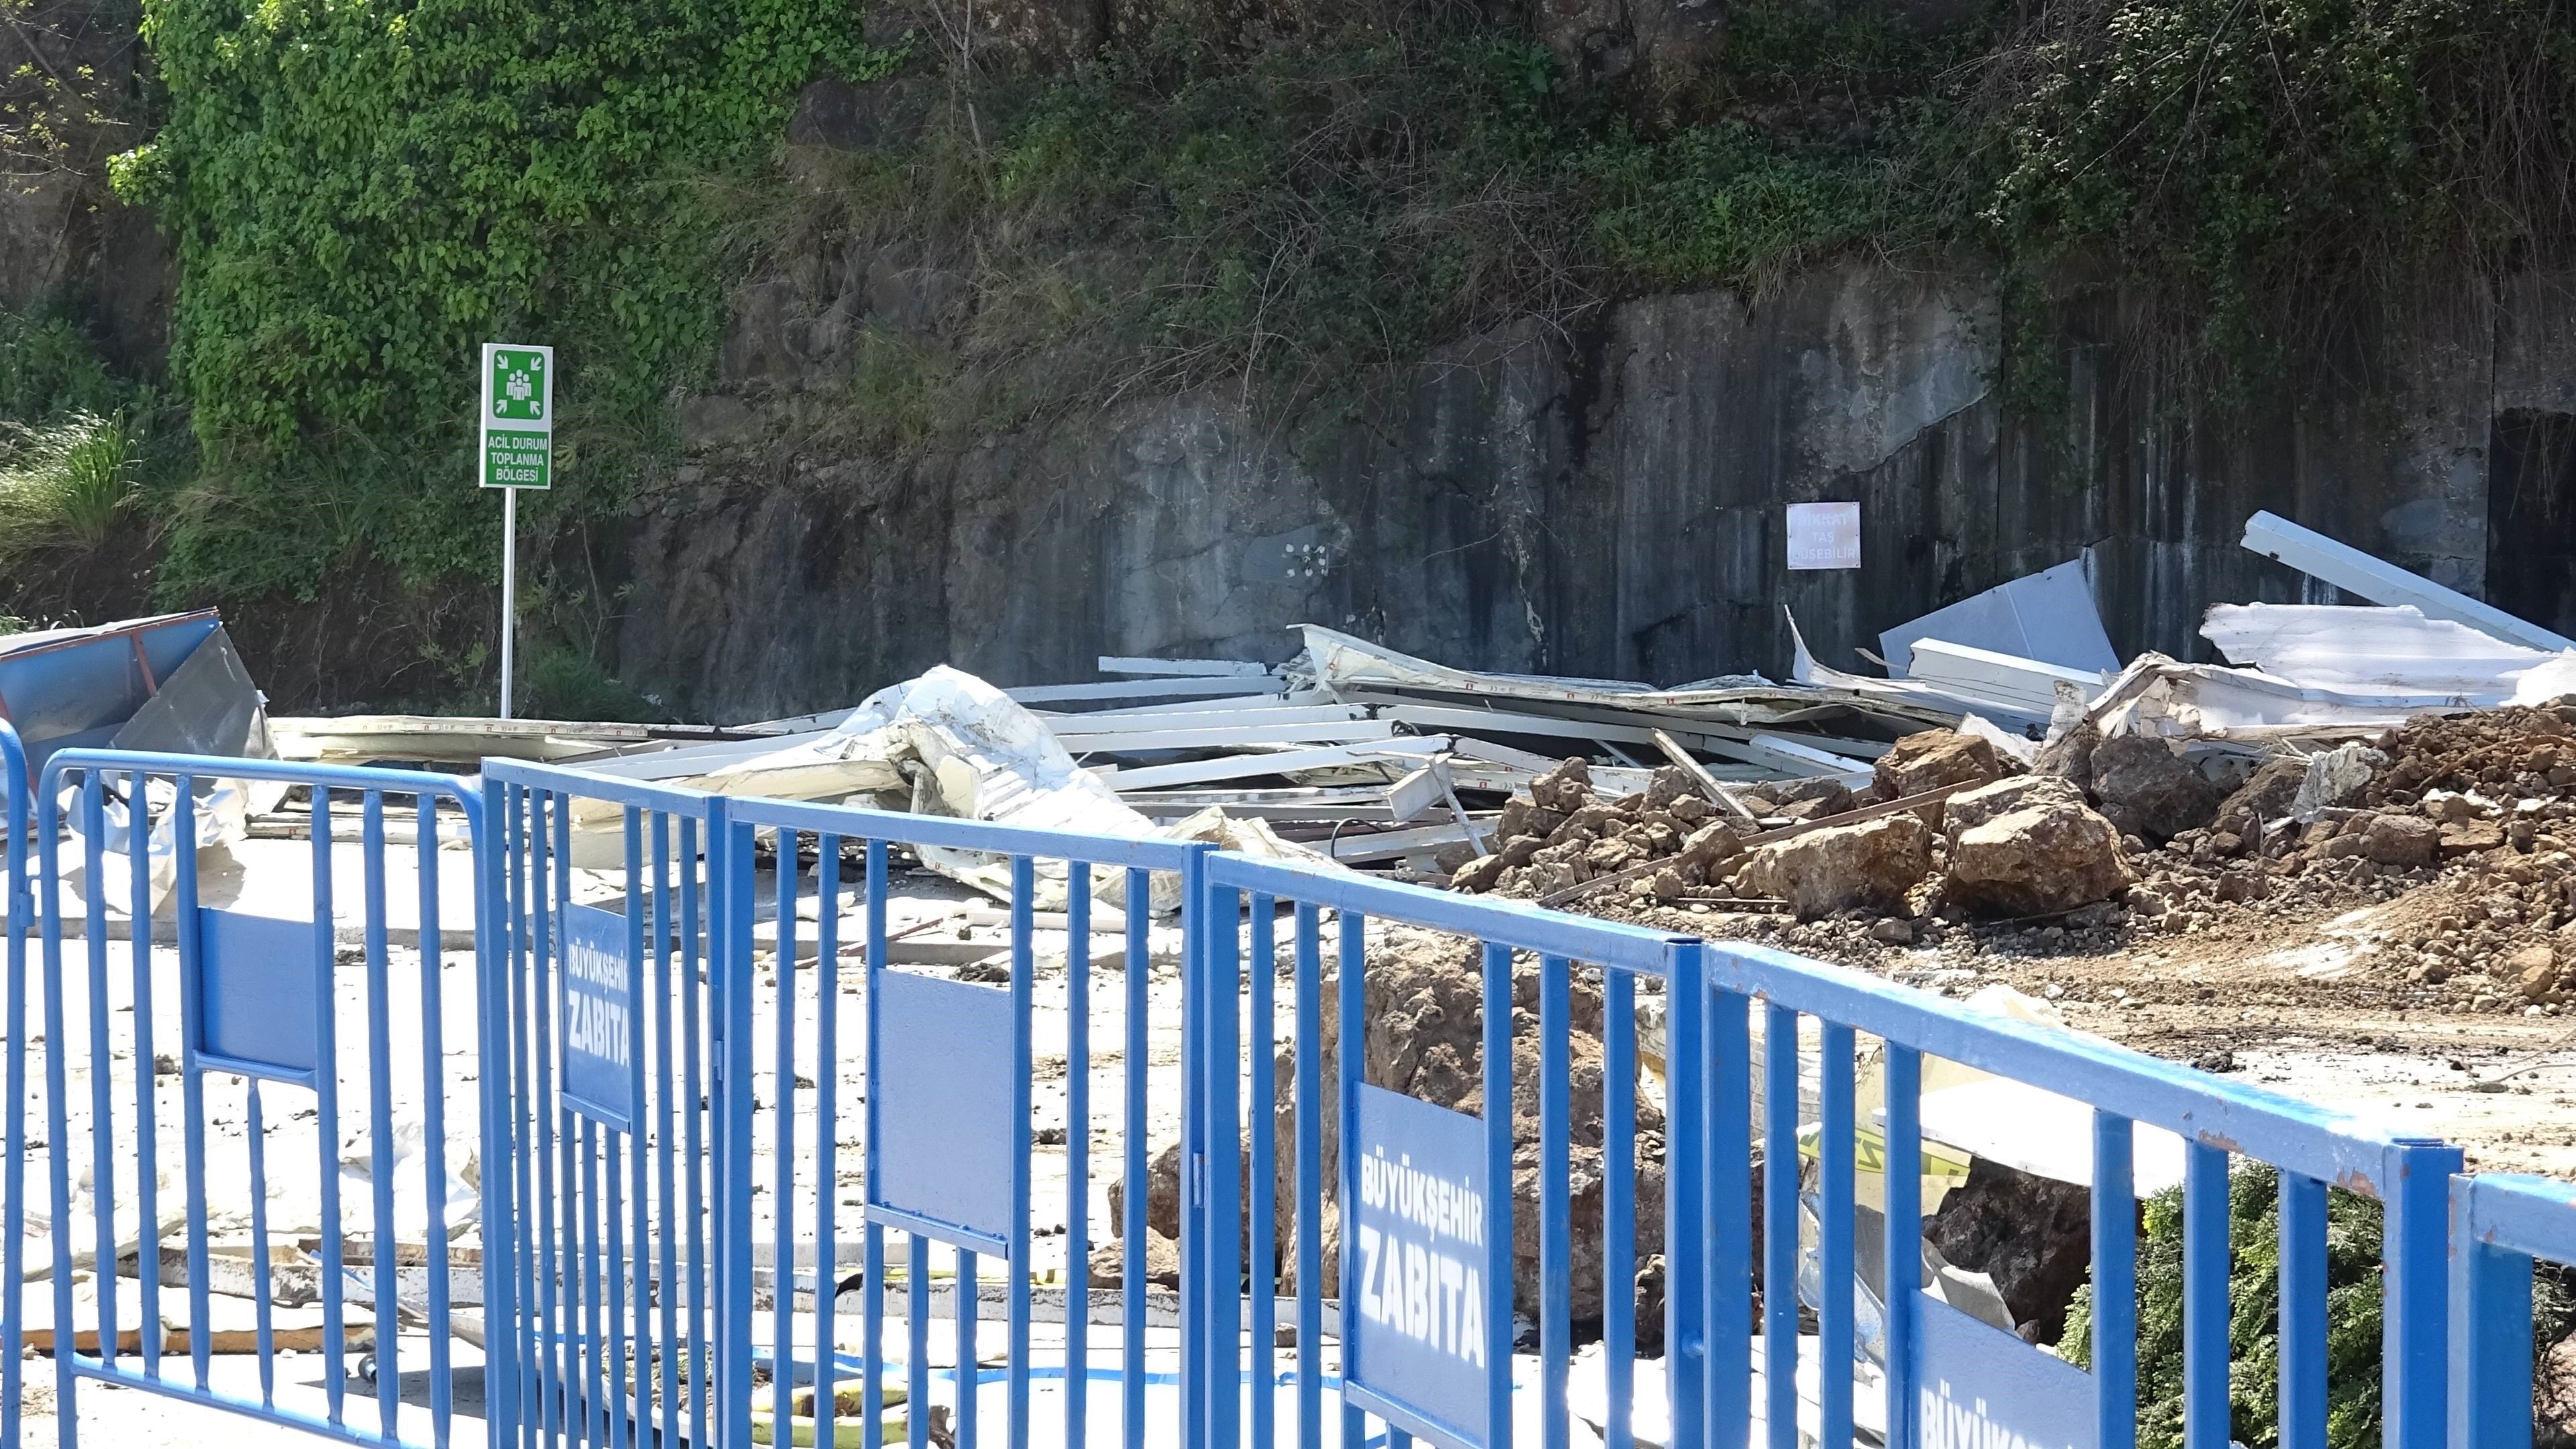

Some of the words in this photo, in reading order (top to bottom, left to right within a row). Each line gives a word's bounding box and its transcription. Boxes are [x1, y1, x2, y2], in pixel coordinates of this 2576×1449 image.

[488, 434, 511, 449] ACİL
[513, 437, 547, 450] DURUM
[490, 452, 544, 466] TOPLANMA
[496, 466, 539, 482] BÖLGESİ
[1813, 531, 1835, 545] TAŞ
[568, 937, 628, 995] BÜYÜKŞEHİR
[568, 989, 629, 1069] ZABITA
[1361, 1144, 1483, 1246] BÜYÜKŞEHİR
[1360, 1224, 1485, 1368] ZABITA
